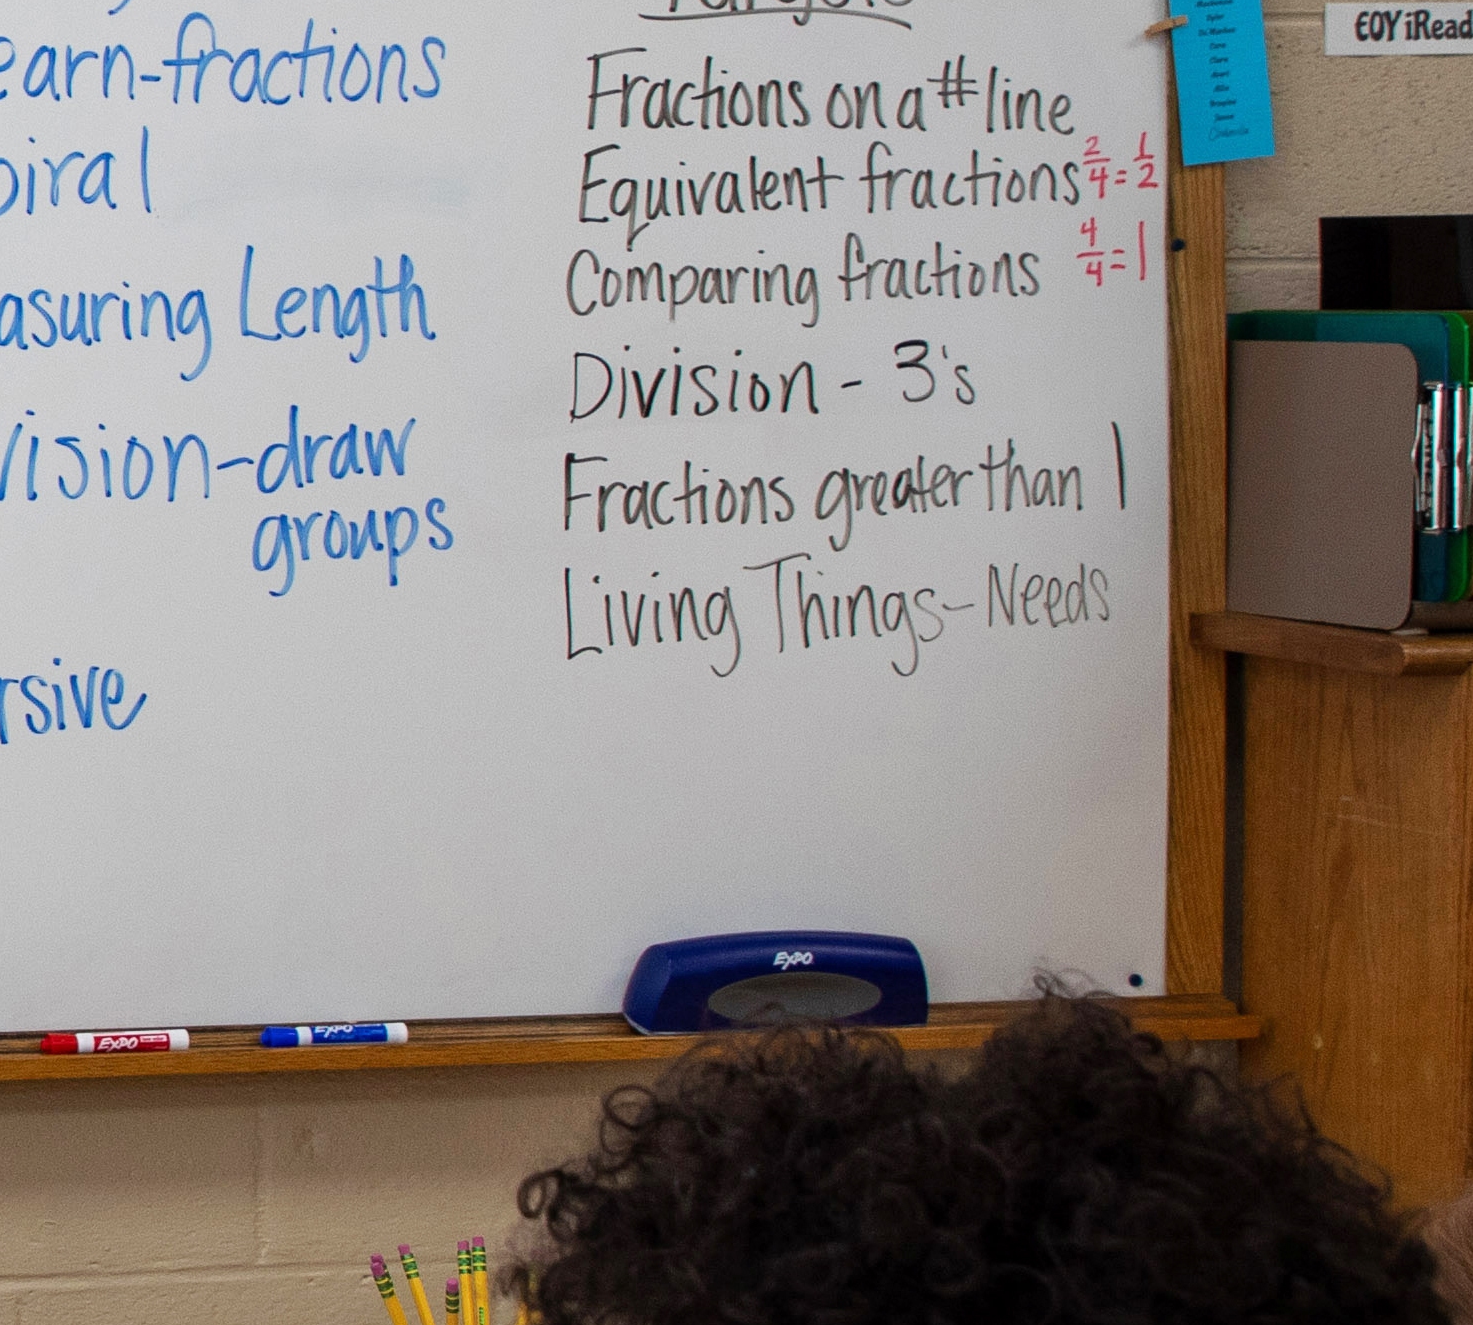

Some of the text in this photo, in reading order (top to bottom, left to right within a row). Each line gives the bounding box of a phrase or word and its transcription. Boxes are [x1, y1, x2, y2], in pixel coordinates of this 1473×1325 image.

[1354, 10, 1402, 41] EOY
[587, 48, 811, 130] Fractions
[579, 141, 1079, 251] Equivalent fractions
[240, 245, 436, 363] Length
[566, 232, 1040, 327] Comparing fractions
[570, 345, 819, 423] Division
[563, 453, 795, 532] Fractions
[814, 455, 972, 552] greater
[980, 438, 1084, 512] than
[253, 498, 454, 597] groups
[564, 568, 741, 677] Living
[773, 950, 814, 969] EXPO
[97, 1037, 138, 1051] EXPO
